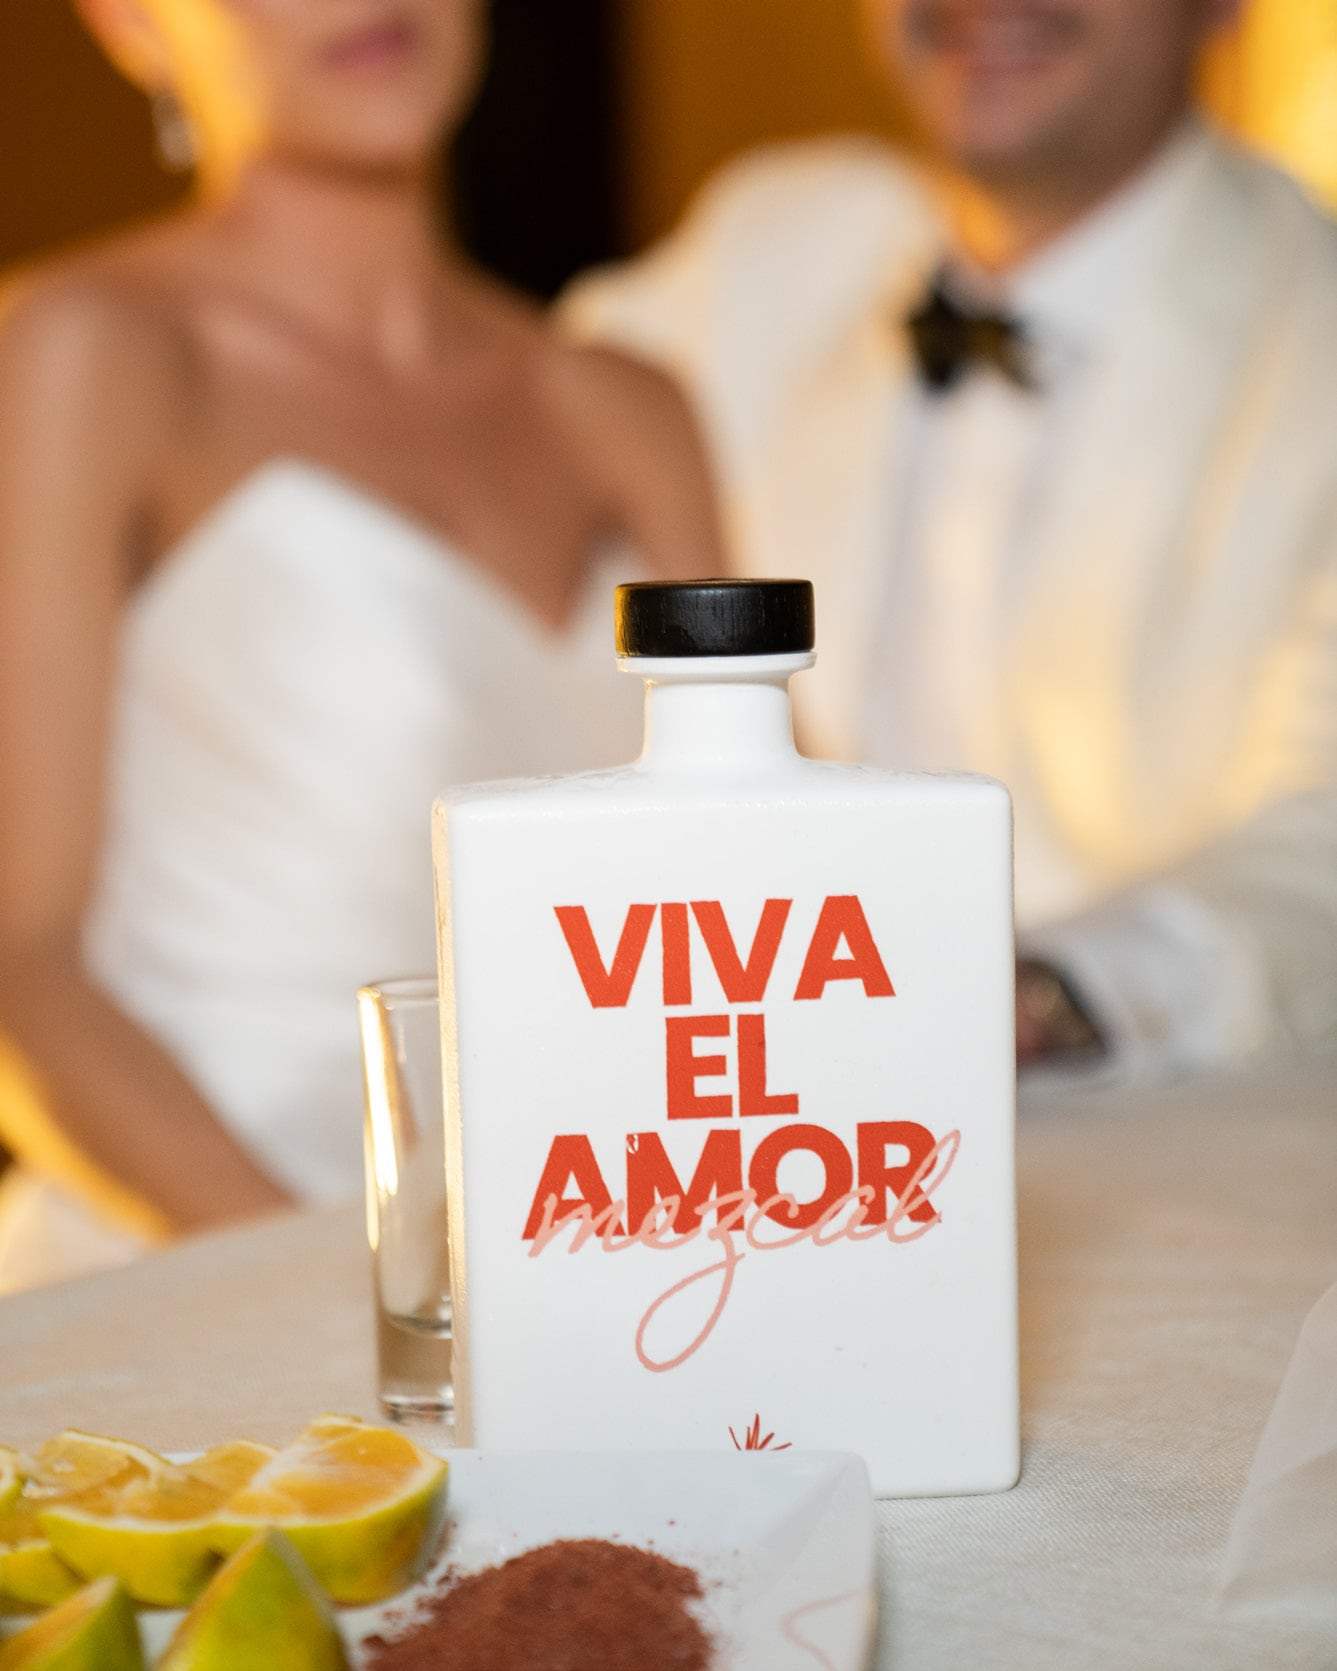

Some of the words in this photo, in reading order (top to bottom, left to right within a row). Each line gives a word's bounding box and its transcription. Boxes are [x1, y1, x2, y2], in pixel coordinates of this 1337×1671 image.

[553, 895, 896, 1008] VIVA
[665, 1013, 800, 1120] EL
[521, 1120, 943, 1240] AMOR
[528, 1129, 962, 1373] mezcal
